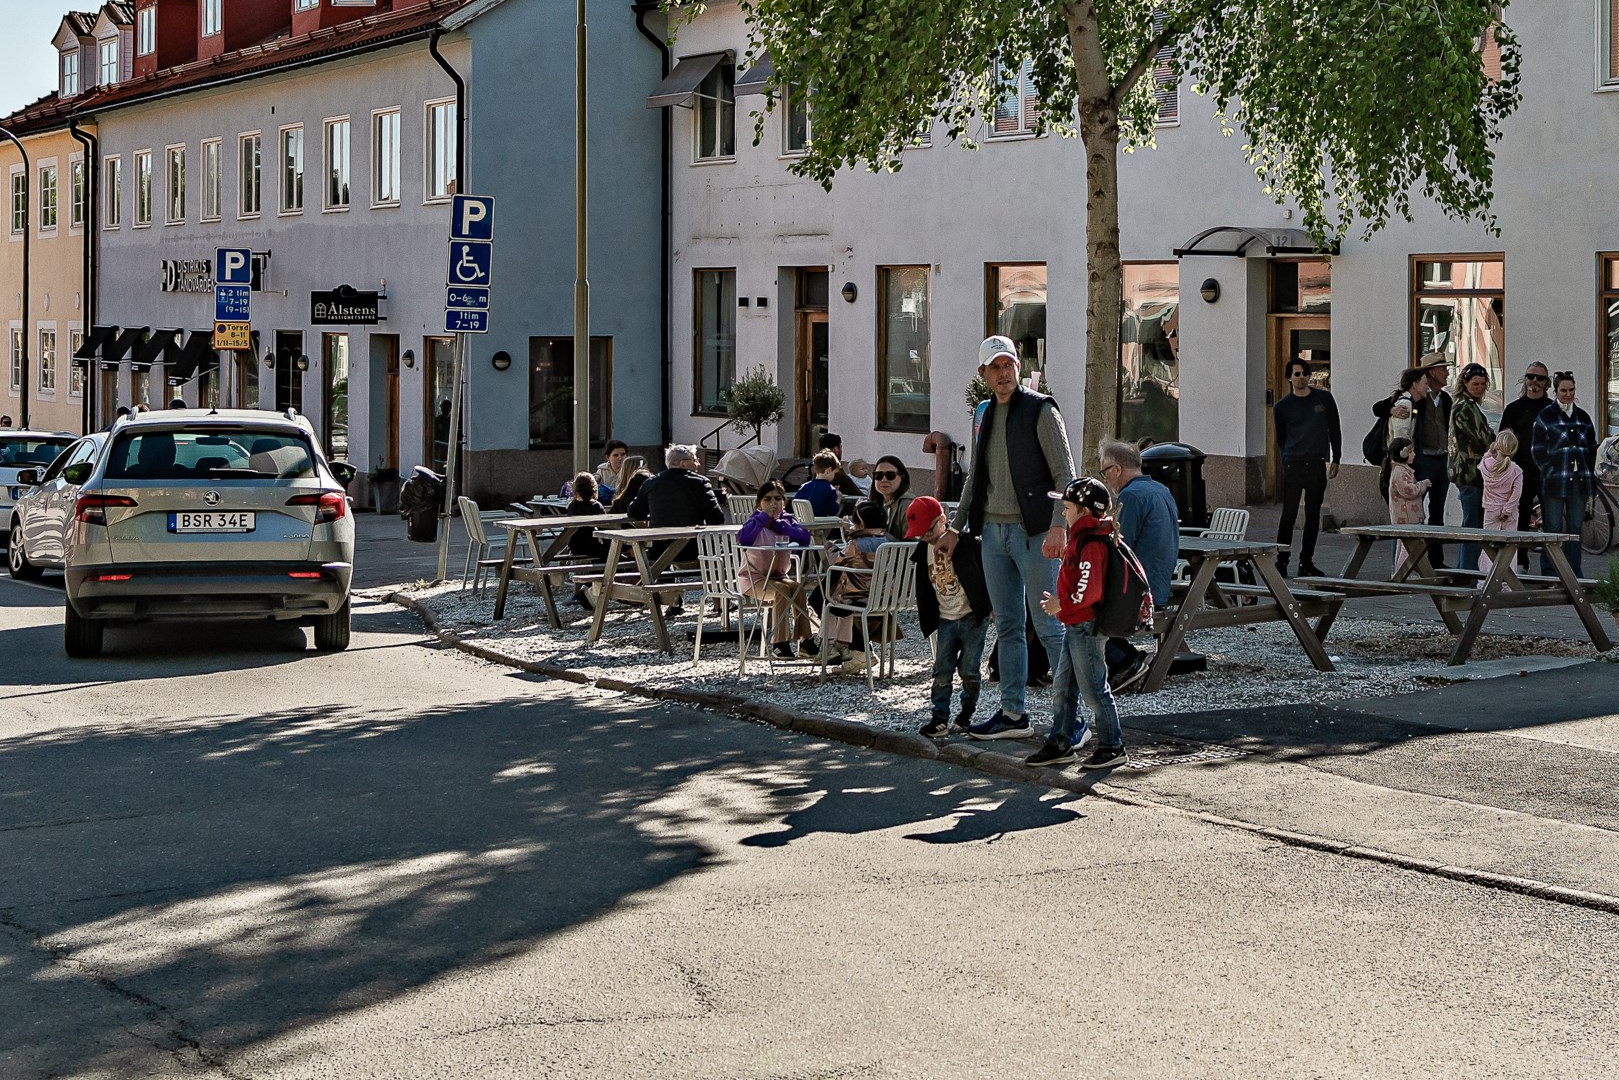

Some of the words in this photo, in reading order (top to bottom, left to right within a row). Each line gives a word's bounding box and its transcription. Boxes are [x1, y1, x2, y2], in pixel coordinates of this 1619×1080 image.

[462, 200, 487, 235] P
[1276, 236, 1288, 247] 12
[225, 251, 245, 280] P
[228, 289, 234, 297] 2
[236, 289, 249, 297] tim
[327, 301, 376, 315] Ålstens
[455, 320, 480, 329] 7-19
[182, 514, 212, 528] BSR
[217, 514, 248, 528] 34E
